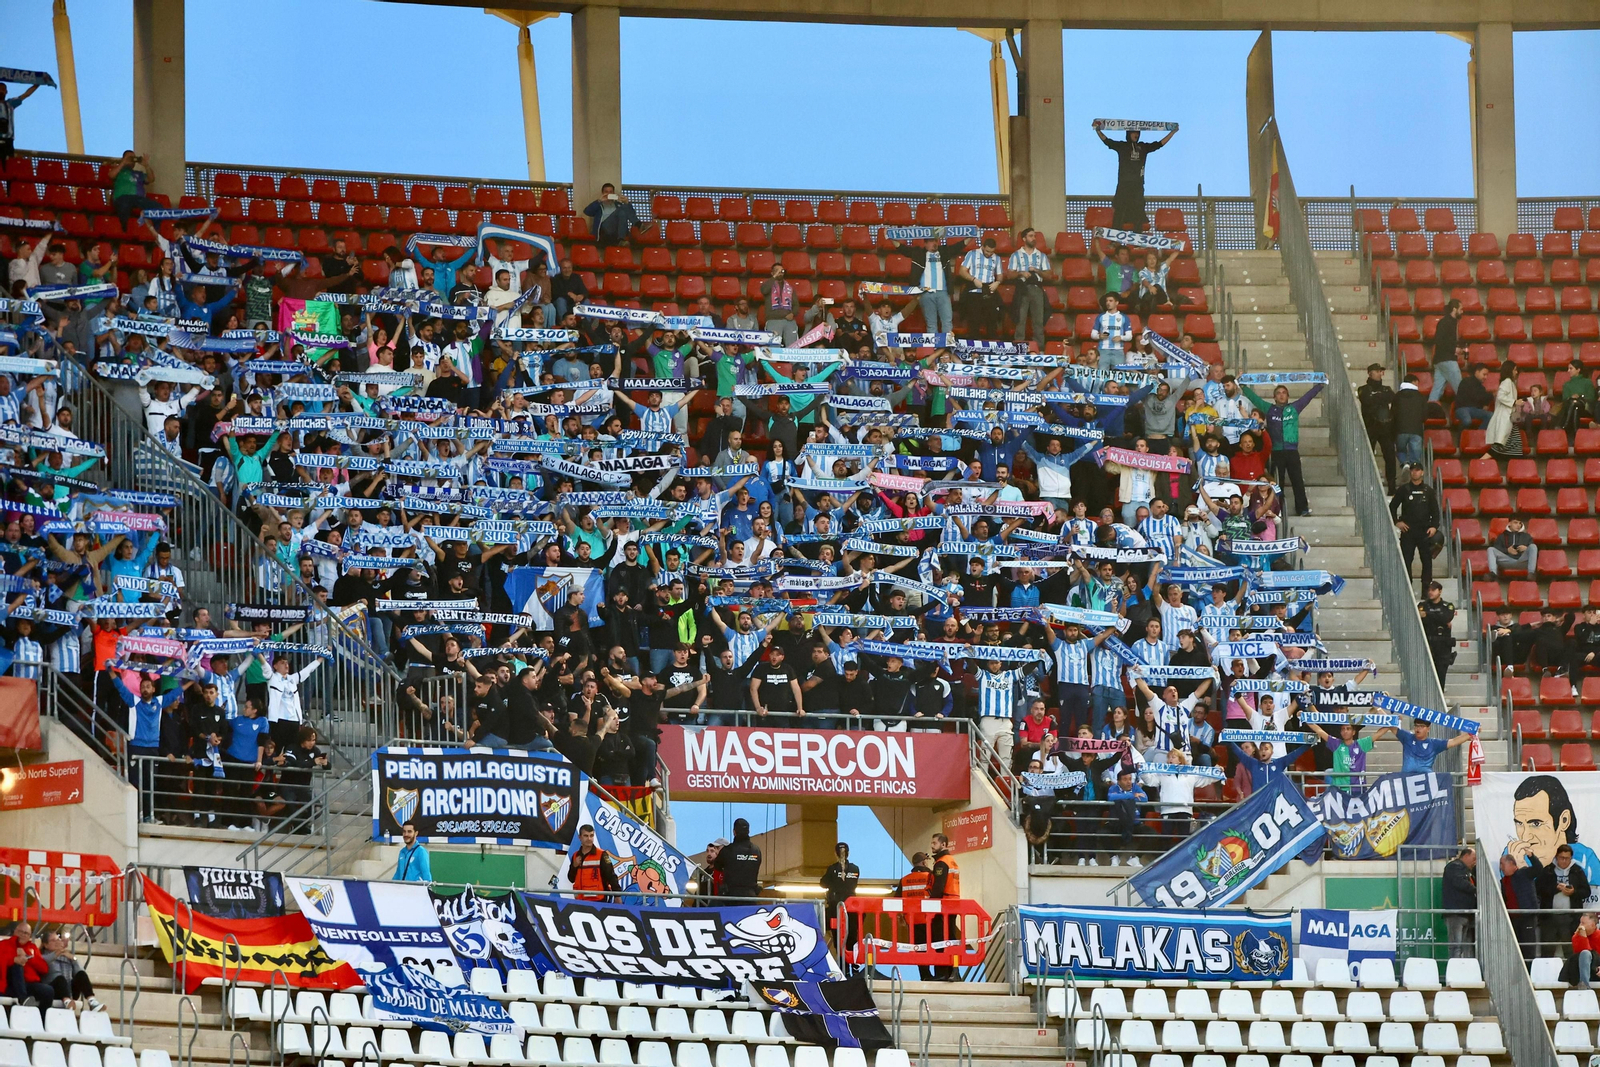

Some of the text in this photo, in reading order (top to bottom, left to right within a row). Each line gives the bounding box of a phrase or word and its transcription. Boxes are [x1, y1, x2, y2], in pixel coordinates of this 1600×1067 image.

[148, 208, 211, 218] MALAGA
[888, 227, 973, 239] FONDO SUR
[1106, 229, 1169, 248] LOS 300
[189, 236, 229, 251] MALAGA
[588, 307, 629, 318] MALAGA
[679, 317, 701, 326] MALAGA
[505, 328, 567, 340] LOS 300
[702, 330, 743, 341] MALAGA
[988, 354, 1056, 365] LOS 300
[249, 361, 308, 374] MALAGA
[951, 364, 1019, 377] LOS 300
[283, 385, 321, 398] MALAGA
[391, 398, 444, 411] MALAGA
[470, 427, 494, 438] SUR
[350, 457, 377, 469] SUR
[491, 461, 532, 470] MALAGA
[600, 455, 664, 473] MALAGA
[1110, 451, 1173, 471] MALAGUISTA
[114, 490, 170, 506] MALAGA
[470, 487, 528, 501] MALAGA
[570, 493, 622, 503] MALAGA
[261, 495, 345, 507] FONDO SUR
[410, 498, 490, 518] FONDO SUR
[528, 522, 555, 534] SUR
[916, 517, 942, 528] SUR
[352, 533, 412, 546] MALAGA
[429, 528, 511, 543] FONDO SUR
[895, 545, 918, 557] SUR
[1240, 540, 1279, 552] MALAGA
[1090, 548, 1144, 560] MALAGA
[1184, 568, 1233, 580] MALAGA
[1273, 573, 1304, 583] MALAGA
[97, 603, 151, 616] MALAGA
[270, 608, 306, 619] GRANDES
[48, 610, 75, 625] SUR
[485, 612, 533, 627] BOKERON
[1202, 616, 1239, 628] ONDO
[869, 642, 937, 658] MALAGA
[977, 647, 1035, 660] MALAGA
[986, 680, 1009, 690] MALAGA
[1319, 692, 1373, 706] MALAGA
[1303, 712, 1393, 726] FONDO SUR
[1386, 699, 1465, 731] SUPERBASTI
[1225, 734, 1251, 742] CIUDAD
[1070, 740, 1128, 751] MALAGA
[684, 730, 917, 778] MASERCON
[28, 766, 79, 779] Norte Superior
[385, 758, 572, 787] PEÑA MALAGUISTA
[687, 772, 917, 795] GESTIÓN Y ADMINISTRACIÓN DE FINCAS
[422, 787, 538, 817] ARCHIDONA
[1306, 772, 1448, 822] ENAMIEL
[1409, 800, 1449, 813] MALAGUISTA
[1250, 792, 1305, 851] 04
[594, 806, 681, 874] CASUALS
[199, 866, 265, 889] YOUTH
[213, 881, 256, 900] MÁLAGA
[311, 923, 444, 945] FUENTEOLLETAS
[534, 904, 728, 957] LOS DE
[1023, 919, 1233, 974] MALAKAS
[556, 945, 786, 982] SIEMPRE
[430, 997, 449, 1015] DE
